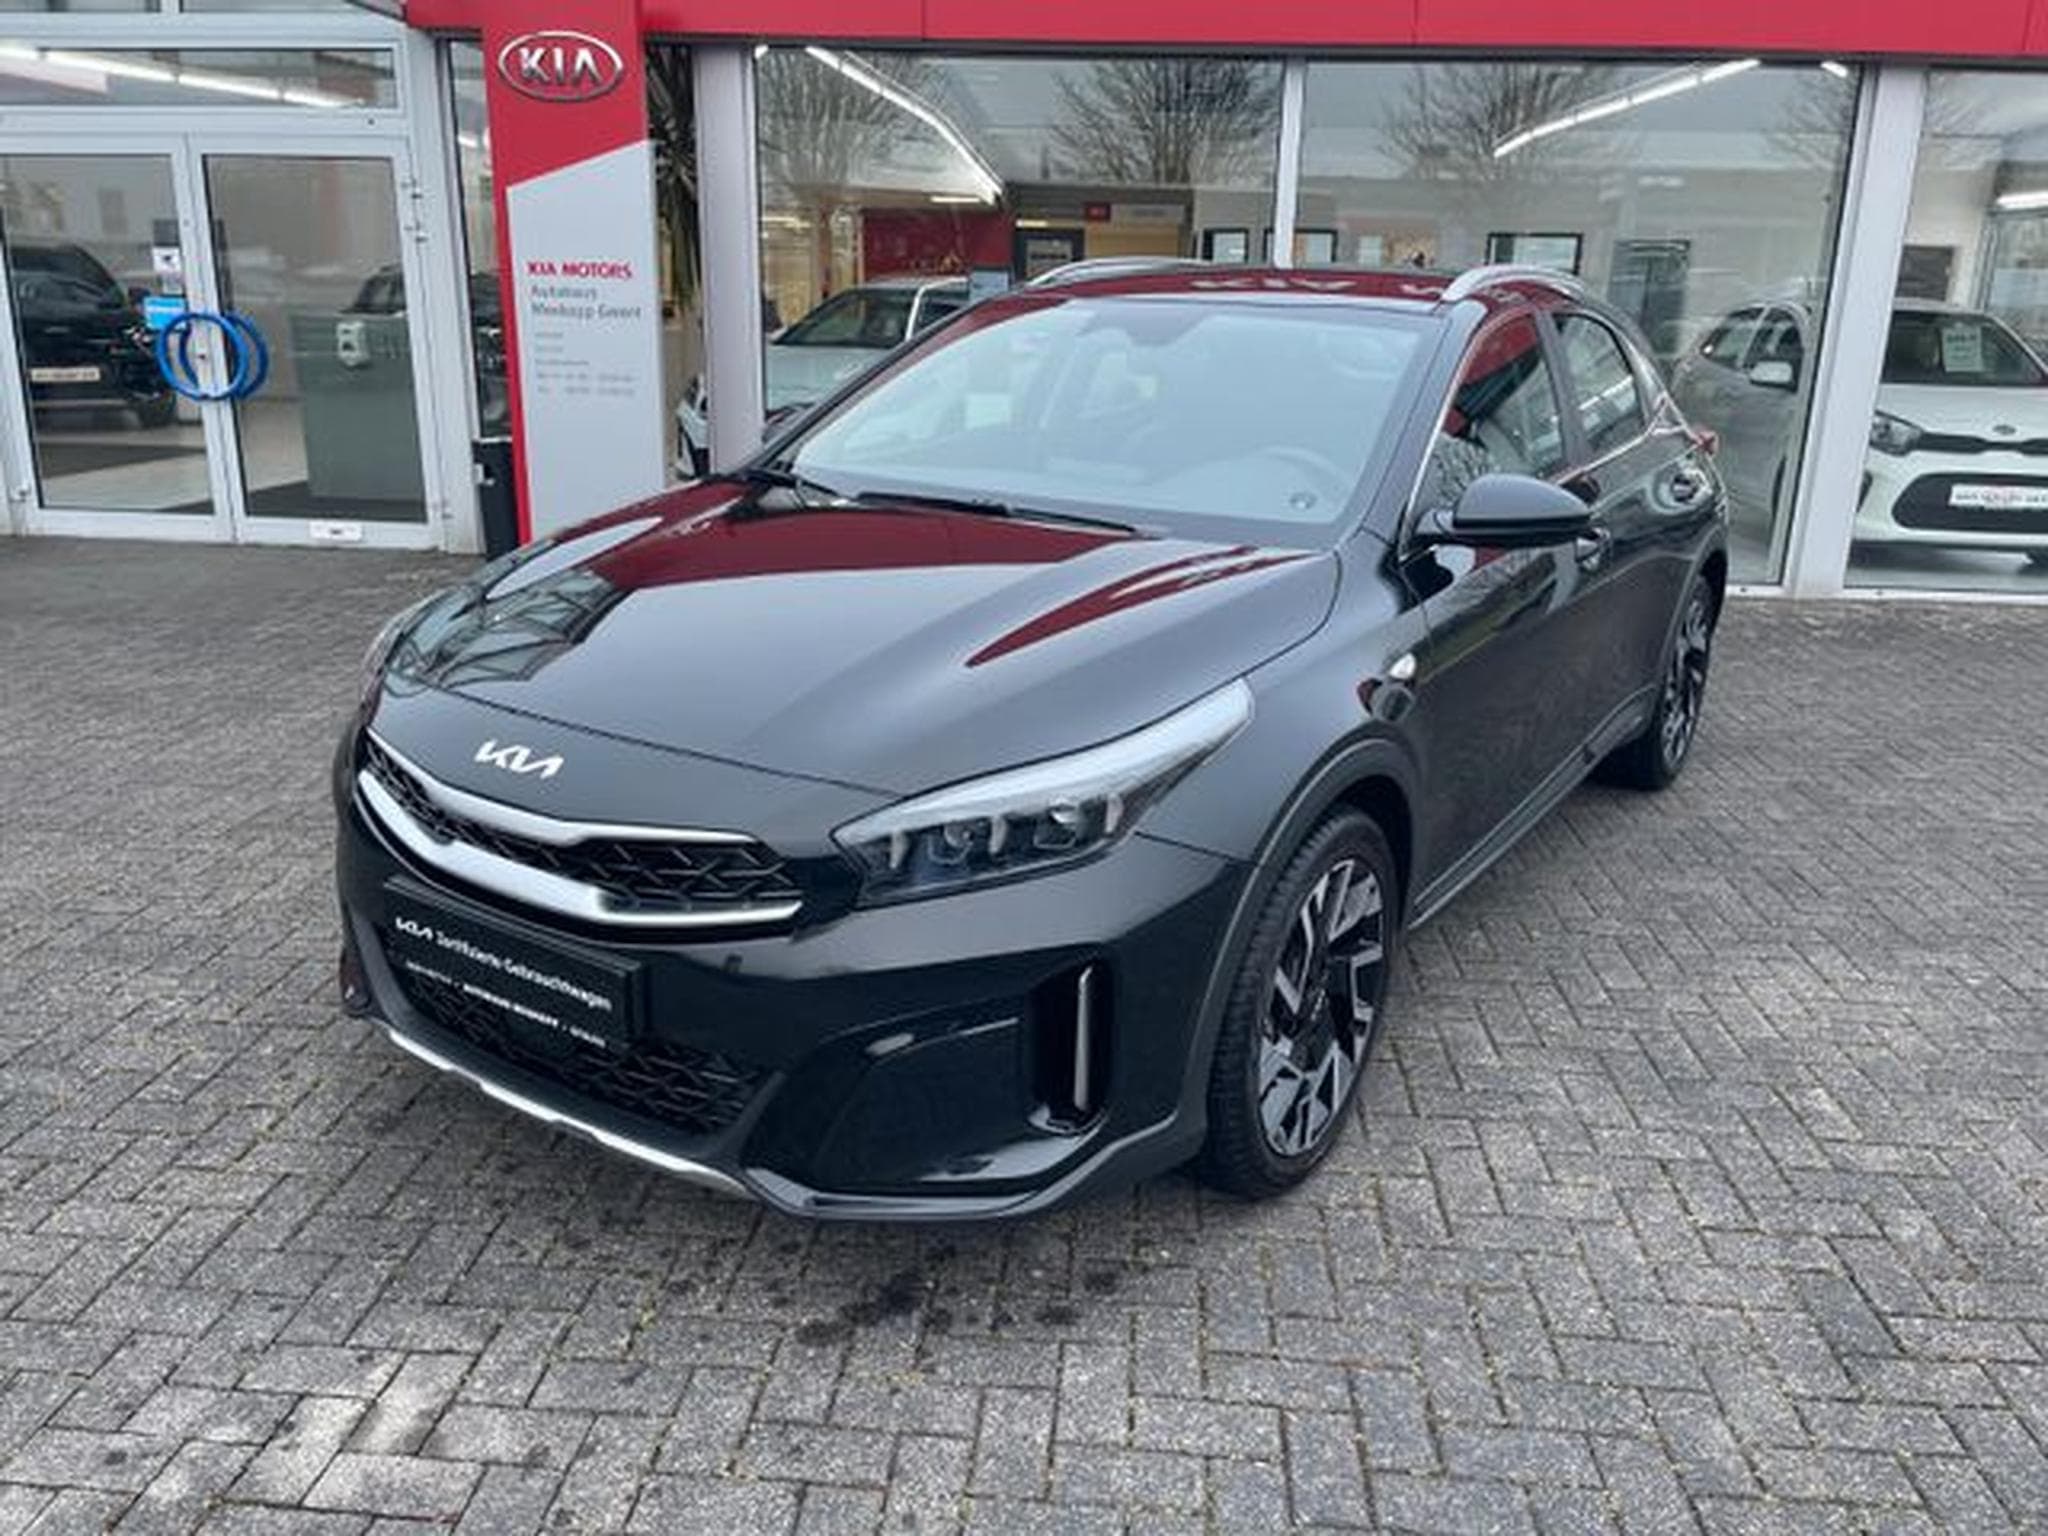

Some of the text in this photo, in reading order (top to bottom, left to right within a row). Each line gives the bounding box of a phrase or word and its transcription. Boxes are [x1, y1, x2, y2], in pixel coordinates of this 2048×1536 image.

[517, 46, 604, 84] KIA
[527, 261, 633, 280] KIA MOTORS
[474, 739, 564, 779] KIA
